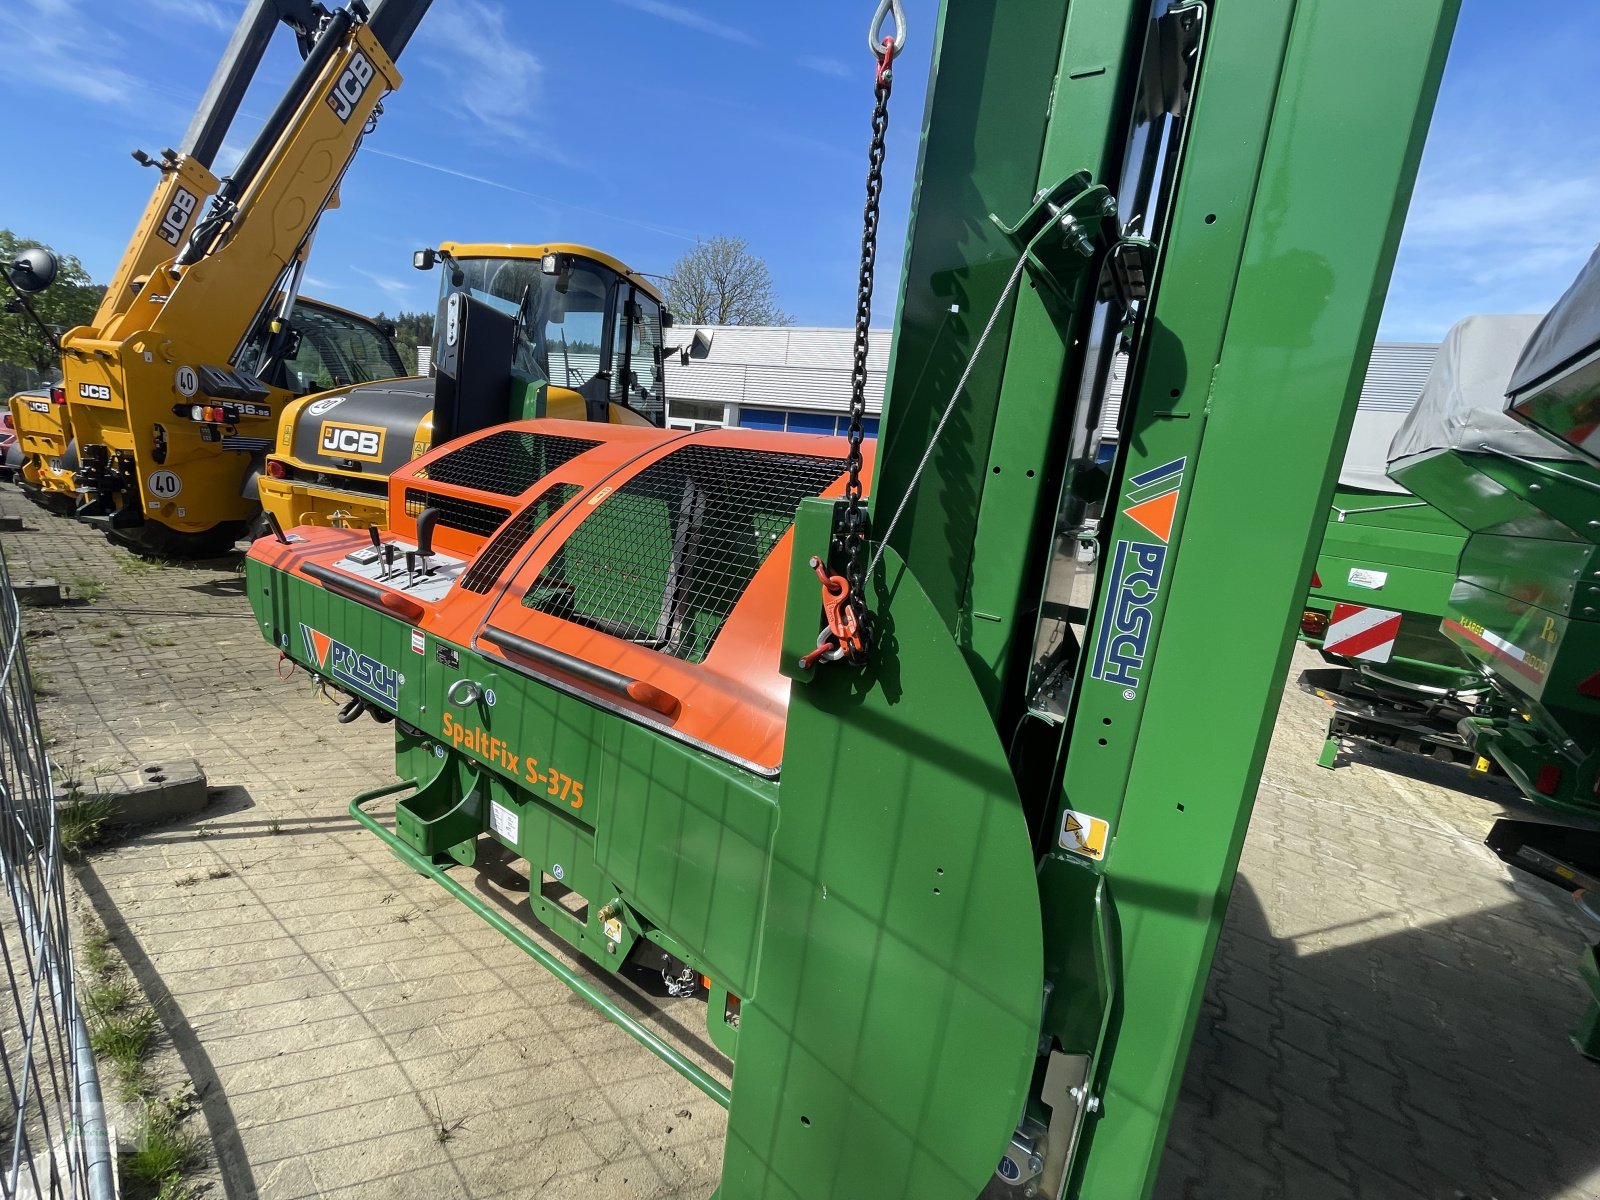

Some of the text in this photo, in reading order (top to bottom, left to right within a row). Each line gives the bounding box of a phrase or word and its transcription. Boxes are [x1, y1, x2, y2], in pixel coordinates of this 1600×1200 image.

[333, 53, 374, 120] JCB
[162, 189, 196, 245] JCB
[80, 384, 110, 399] JCB
[180, 372, 194, 390] 40
[30, 402, 50, 412] JCB
[323, 429, 379, 455] JCB
[52, 459, 62, 472] 20
[155, 476, 176, 493] 40
[1104, 541, 1168, 688] POSCH
[1460, 615, 1484, 637] X-LARGE
[331, 638, 398, 700] POSCH
[442, 712, 584, 809] SpaltFix S-375
